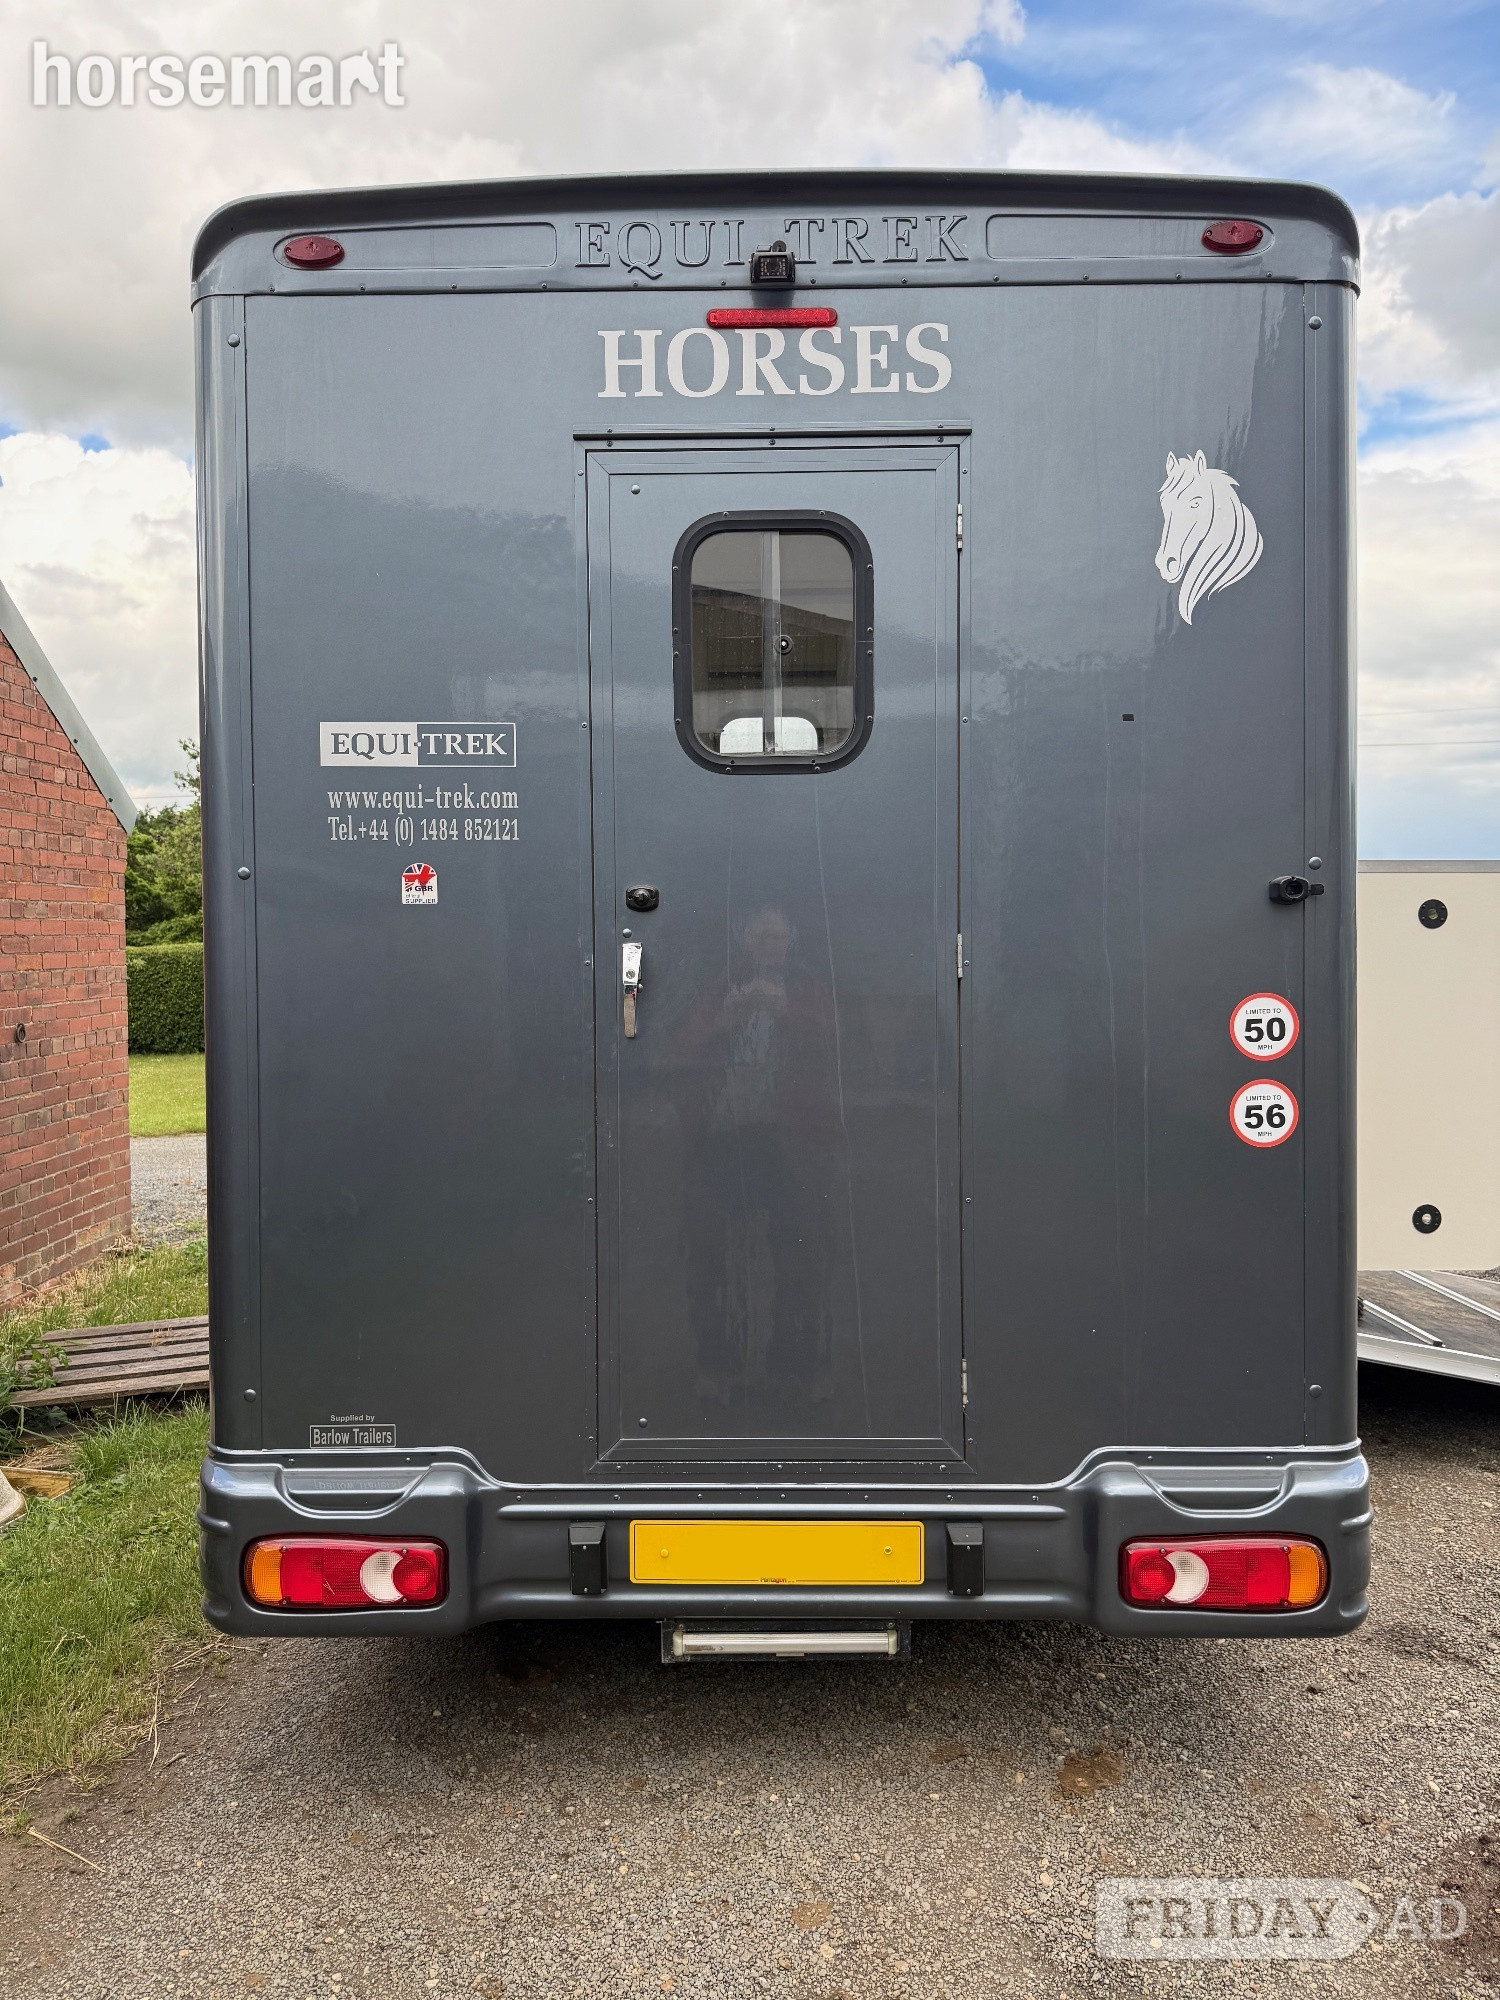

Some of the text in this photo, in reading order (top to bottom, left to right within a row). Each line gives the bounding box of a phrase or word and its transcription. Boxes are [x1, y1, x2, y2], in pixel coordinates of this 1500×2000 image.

[574, 214, 969, 280] EQUI TREK
[597, 322, 953, 398] HORSES
[327, 783, 519, 815] www.equi-trek.com
[327, 815, 520, 847] Tel.+44 (0) 1484 852121
[1244, 1017, 1286, 1043] 50
[1244, 1103, 1286, 1130] 56
[330, 1414, 375, 1423] Supplied by
[313, 1427, 393, 1445] Barlow Trailers
